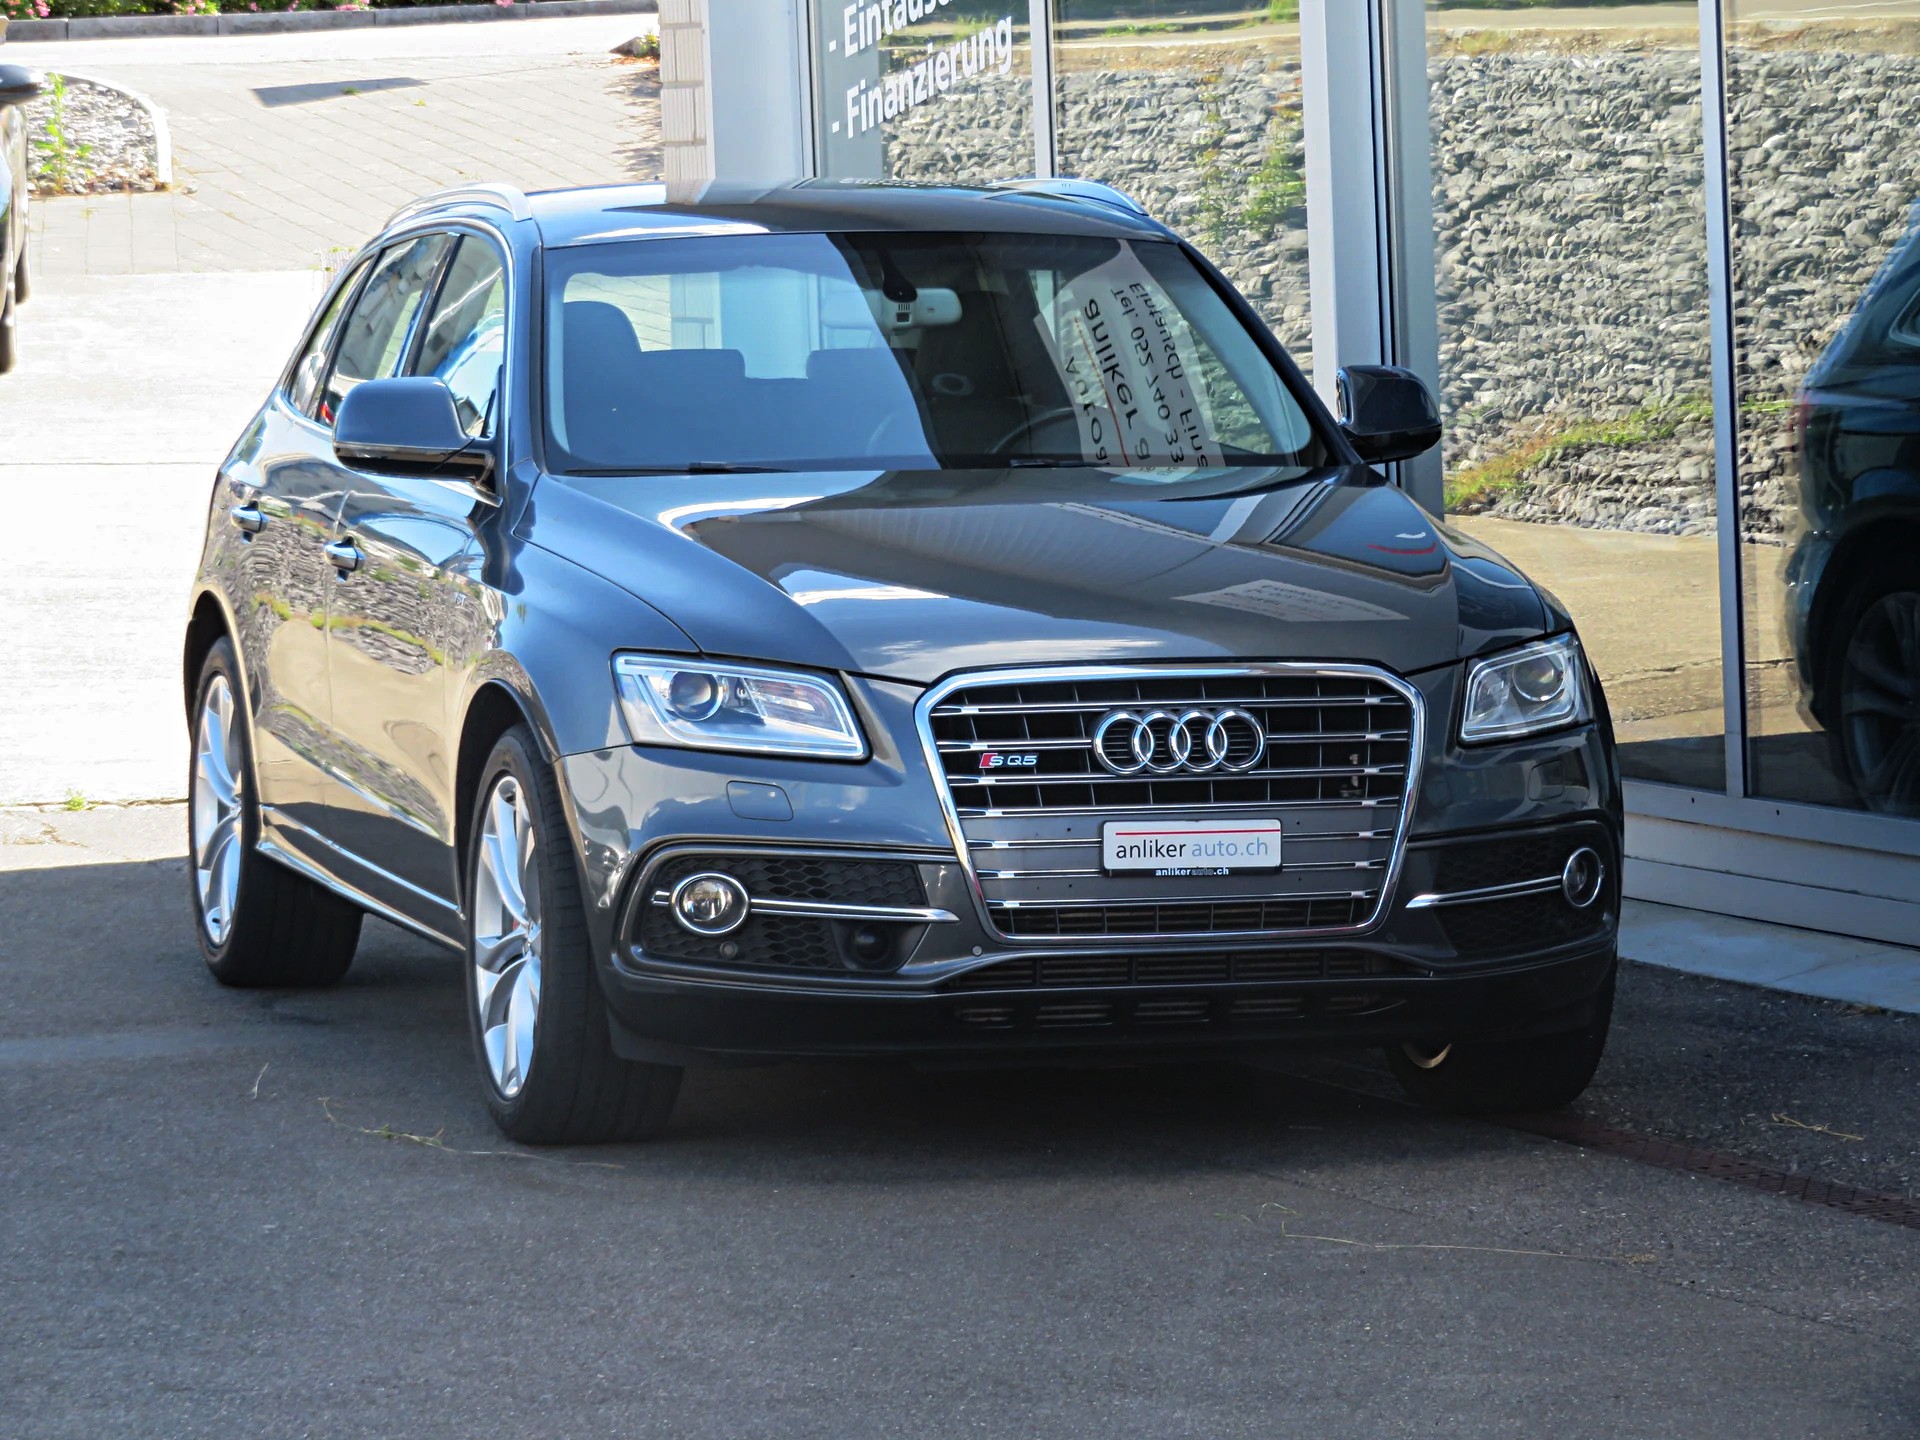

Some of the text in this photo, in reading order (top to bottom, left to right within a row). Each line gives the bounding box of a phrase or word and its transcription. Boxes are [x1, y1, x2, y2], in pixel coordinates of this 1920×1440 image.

[846, 16, 1013, 139] Finanzierung
[1115, 837, 1268, 859] anliker auto.ch
